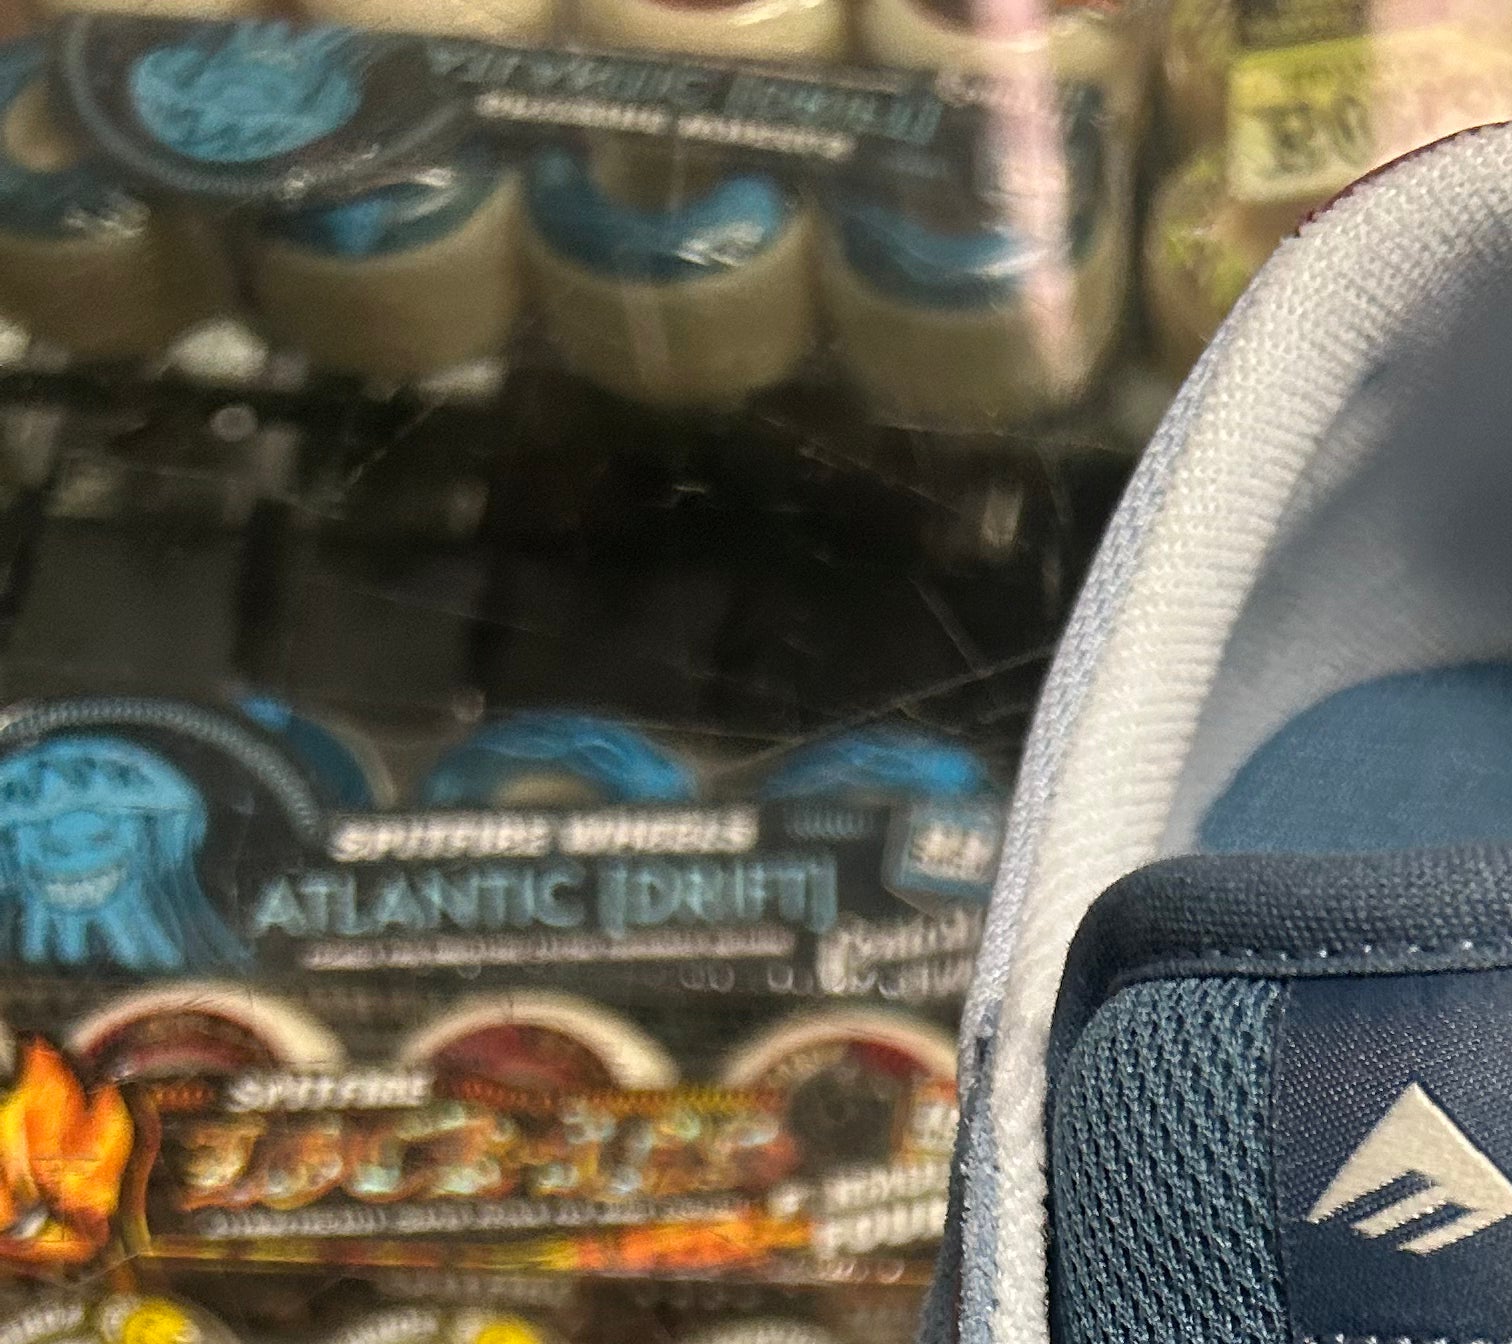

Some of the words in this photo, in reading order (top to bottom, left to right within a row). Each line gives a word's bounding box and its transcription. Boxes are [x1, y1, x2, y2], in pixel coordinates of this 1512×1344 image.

[328, 810, 552, 864] SPITFIRE
[556, 804, 760, 856] WHEELS
[250, 860, 590, 940] ATLANTIC
